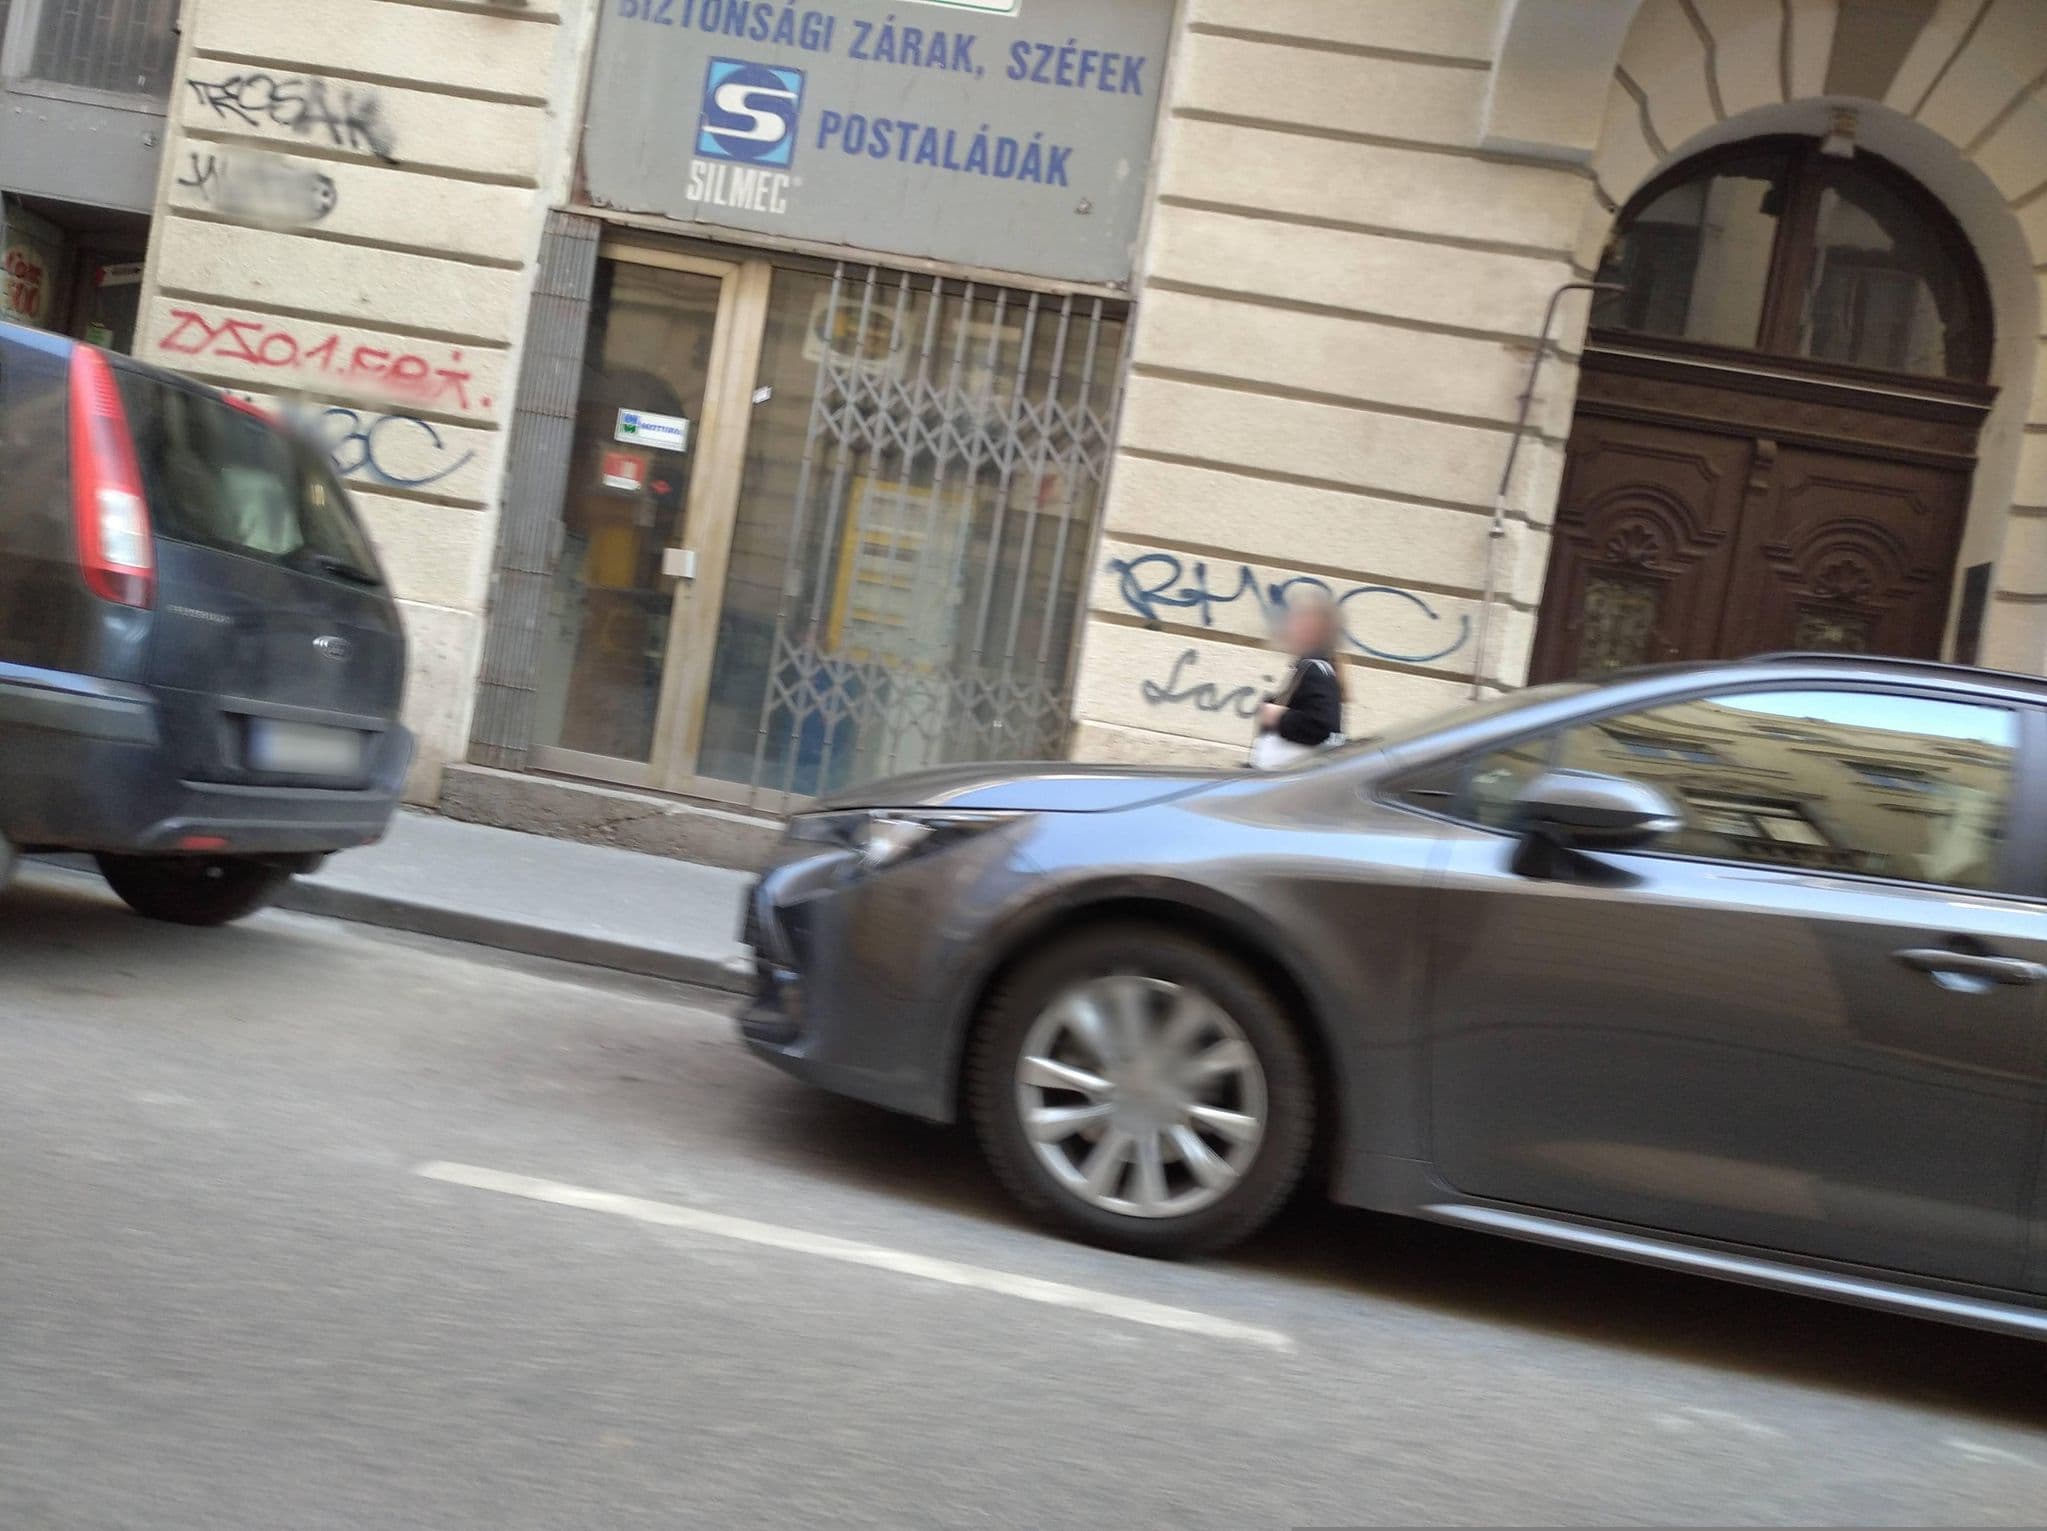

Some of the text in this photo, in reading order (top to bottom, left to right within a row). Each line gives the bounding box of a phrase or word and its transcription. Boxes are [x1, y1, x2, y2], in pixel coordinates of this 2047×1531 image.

[848, 13, 985, 78] ZÁRAK,
[1006, 37, 1148, 96] SZÉFEK
[815, 108, 1073, 188] POSTALÁDÁK
